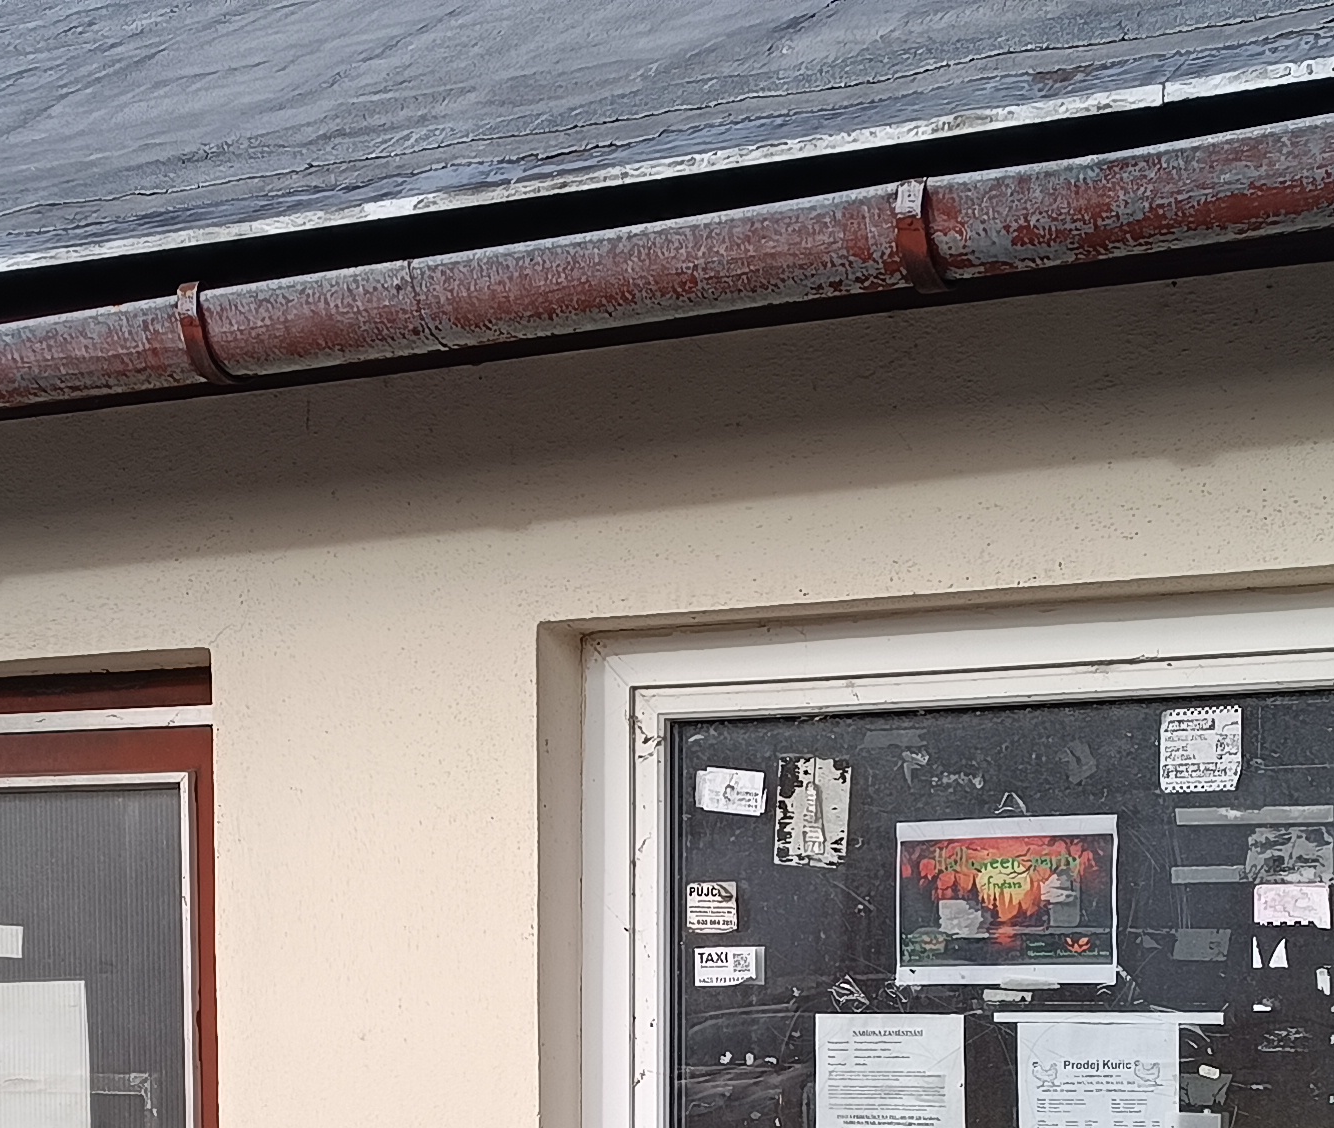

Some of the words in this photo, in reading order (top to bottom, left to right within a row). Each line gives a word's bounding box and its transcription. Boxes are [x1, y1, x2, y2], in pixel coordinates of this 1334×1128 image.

[935, 847, 1021, 873] Halloween
[1032, 854, 1080, 876] party
[698, 952, 728, 963] TAXI
